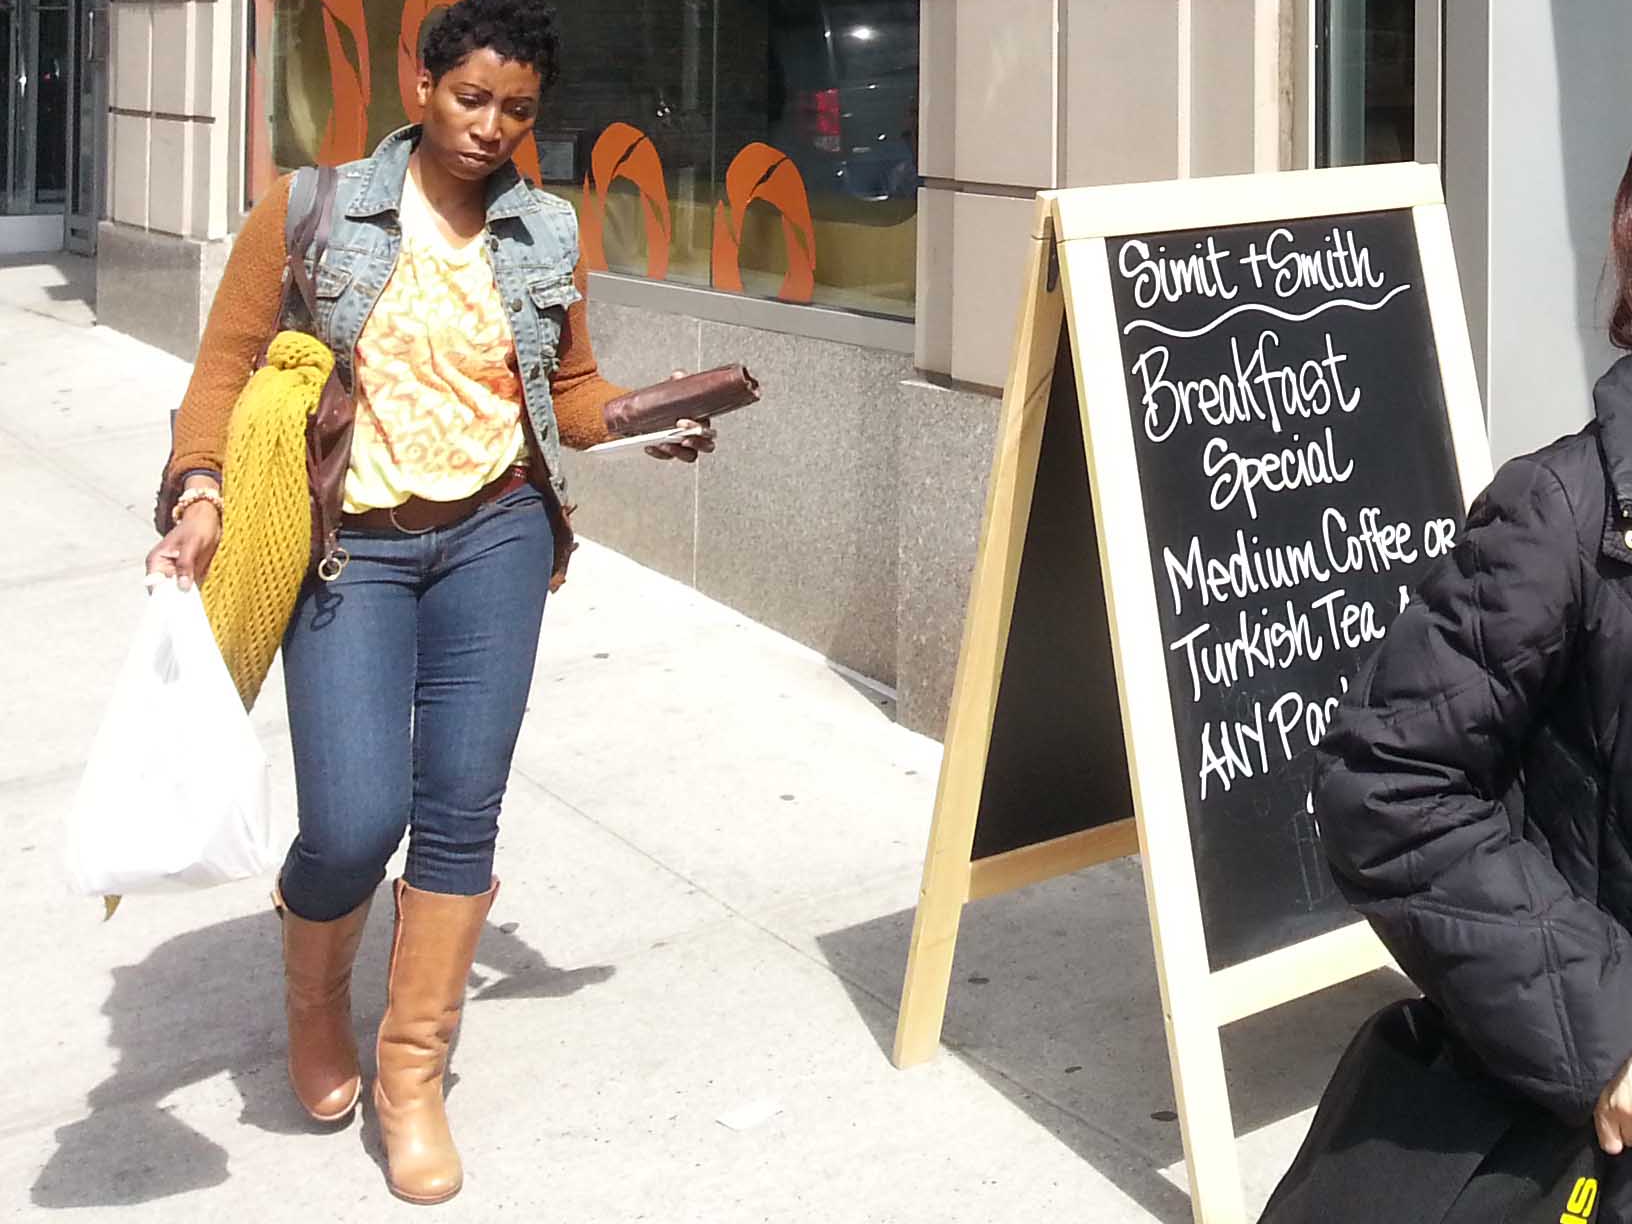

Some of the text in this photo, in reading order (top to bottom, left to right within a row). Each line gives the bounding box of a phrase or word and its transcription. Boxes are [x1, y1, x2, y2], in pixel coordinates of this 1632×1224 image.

[1119, 237, 1238, 309] Simit
[1132, 330, 1361, 444] Breakfast
[1203, 426, 1354, 519] Special
[1163, 528, 1328, 615] Medium
[1322, 505, 1418, 575] Coffee
[1170, 588, 1386, 700] Turkish Tea
[1198, 704, 1269, 801] ANY
